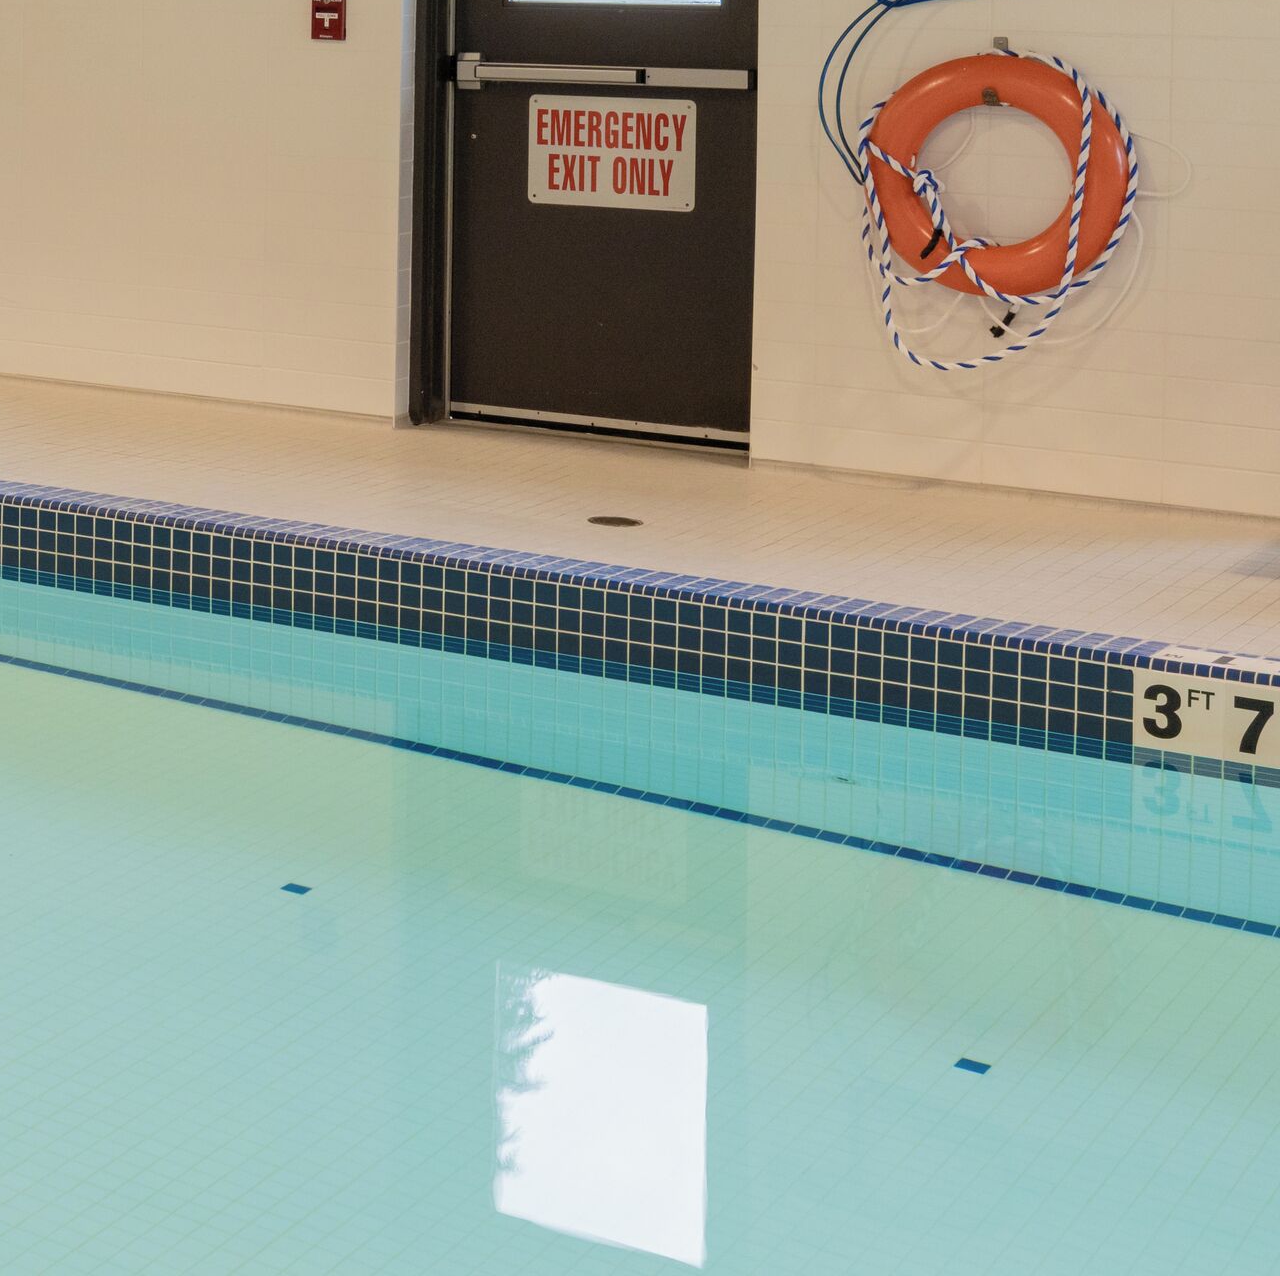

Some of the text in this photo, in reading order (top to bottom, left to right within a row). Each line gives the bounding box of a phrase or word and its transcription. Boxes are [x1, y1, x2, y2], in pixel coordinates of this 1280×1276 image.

[536, 108, 687, 152] EMERGENCY
[548, 153, 674, 197] EXIT ONLY
[1233, 695, 1275, 755] 7
